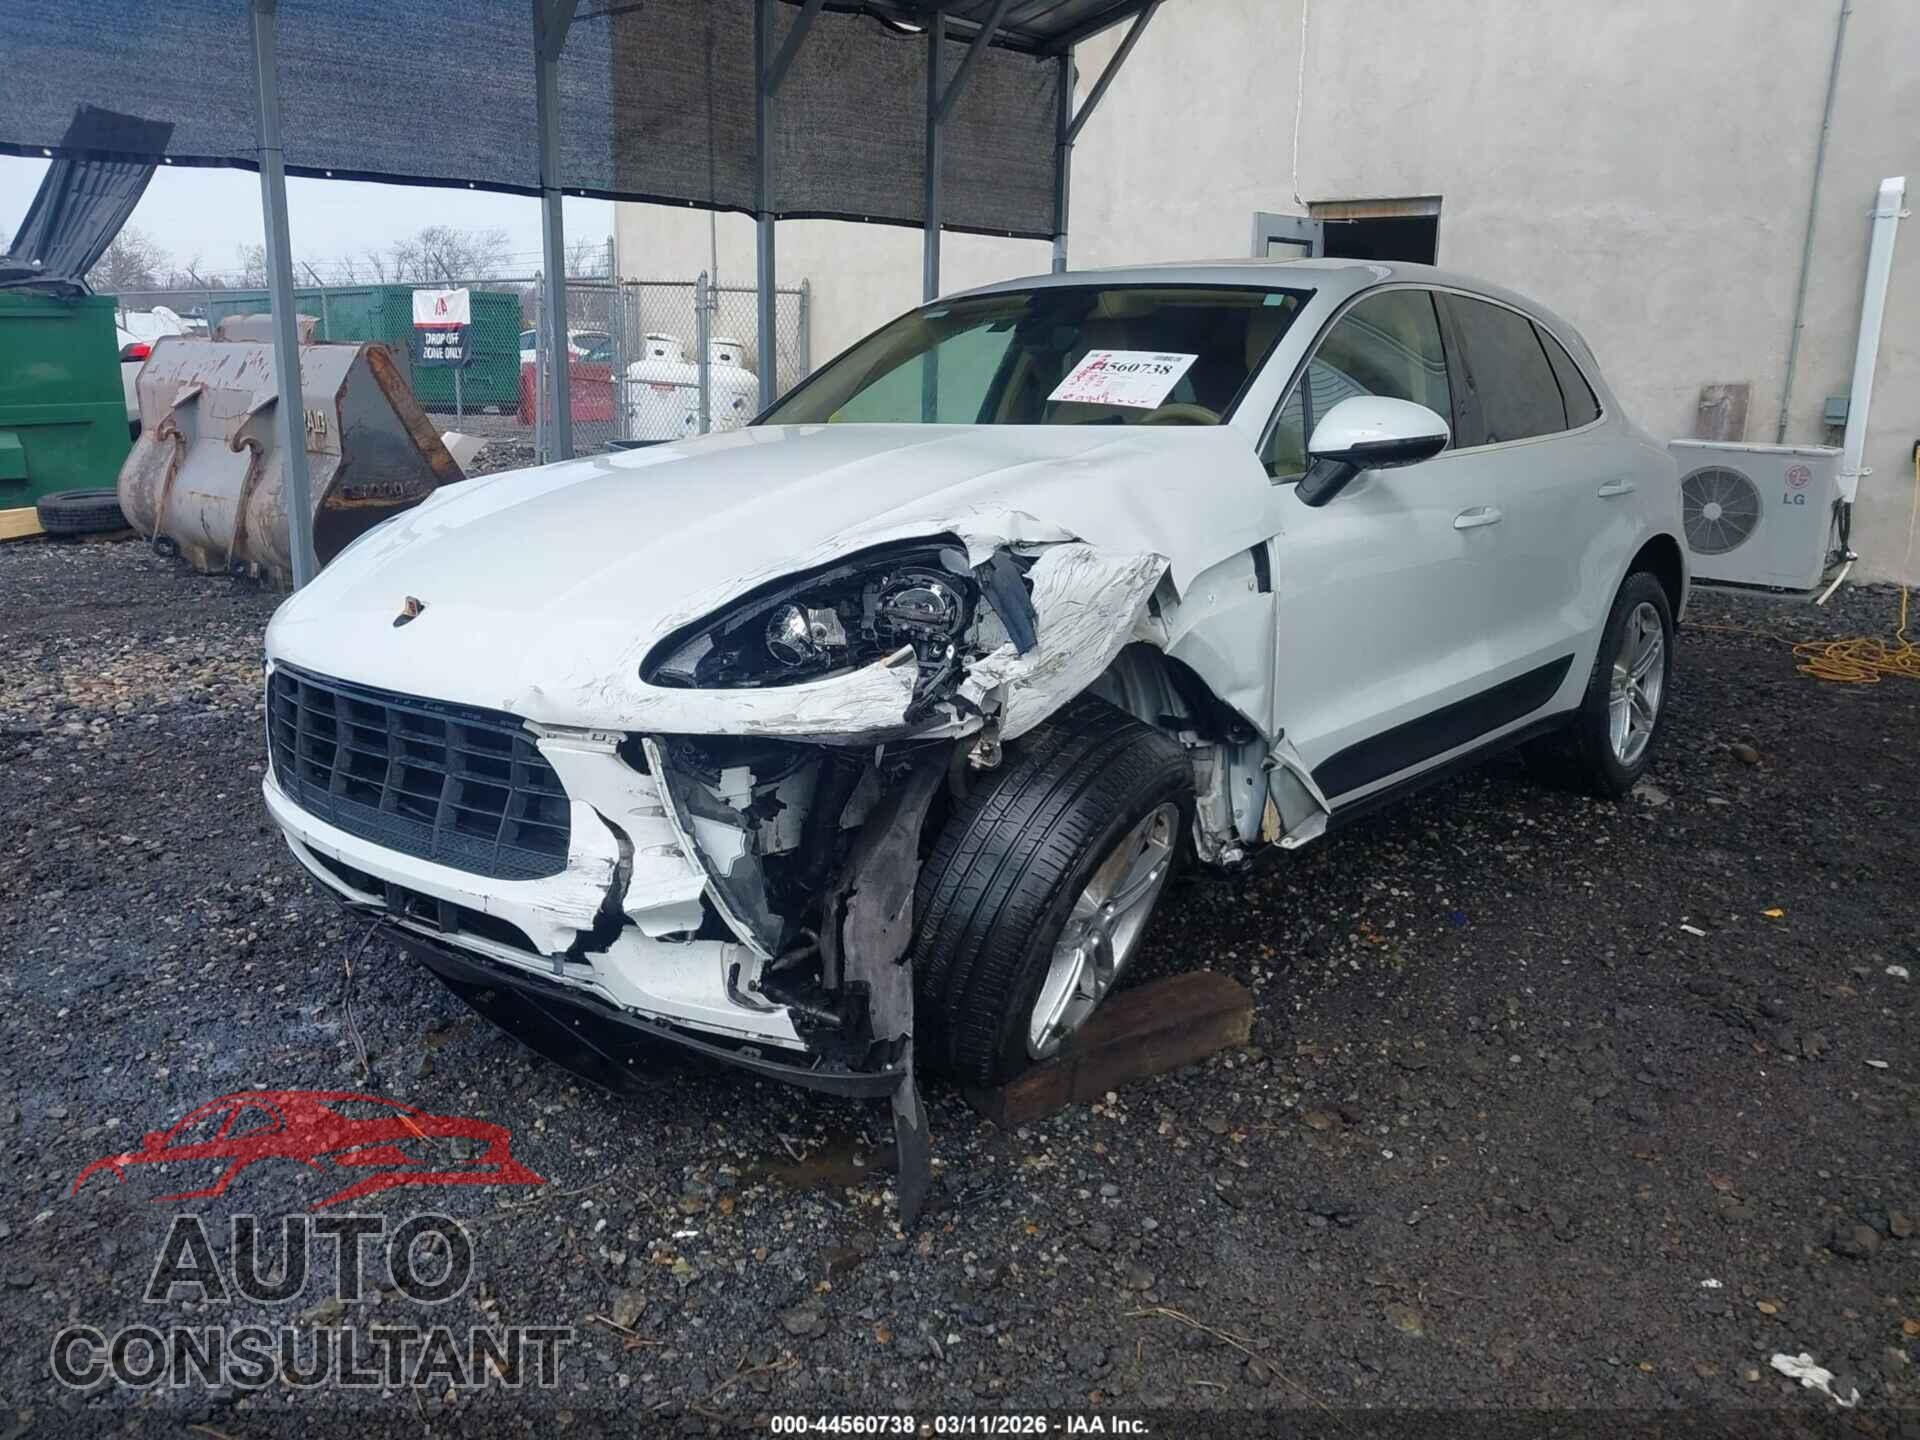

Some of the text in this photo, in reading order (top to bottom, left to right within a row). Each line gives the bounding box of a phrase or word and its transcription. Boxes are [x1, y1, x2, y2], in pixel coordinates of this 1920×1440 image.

[425, 332, 460, 345] DROP OFF
[423, 347, 463, 359] ZONE ONLY
[1783, 492, 1805, 505] LG
